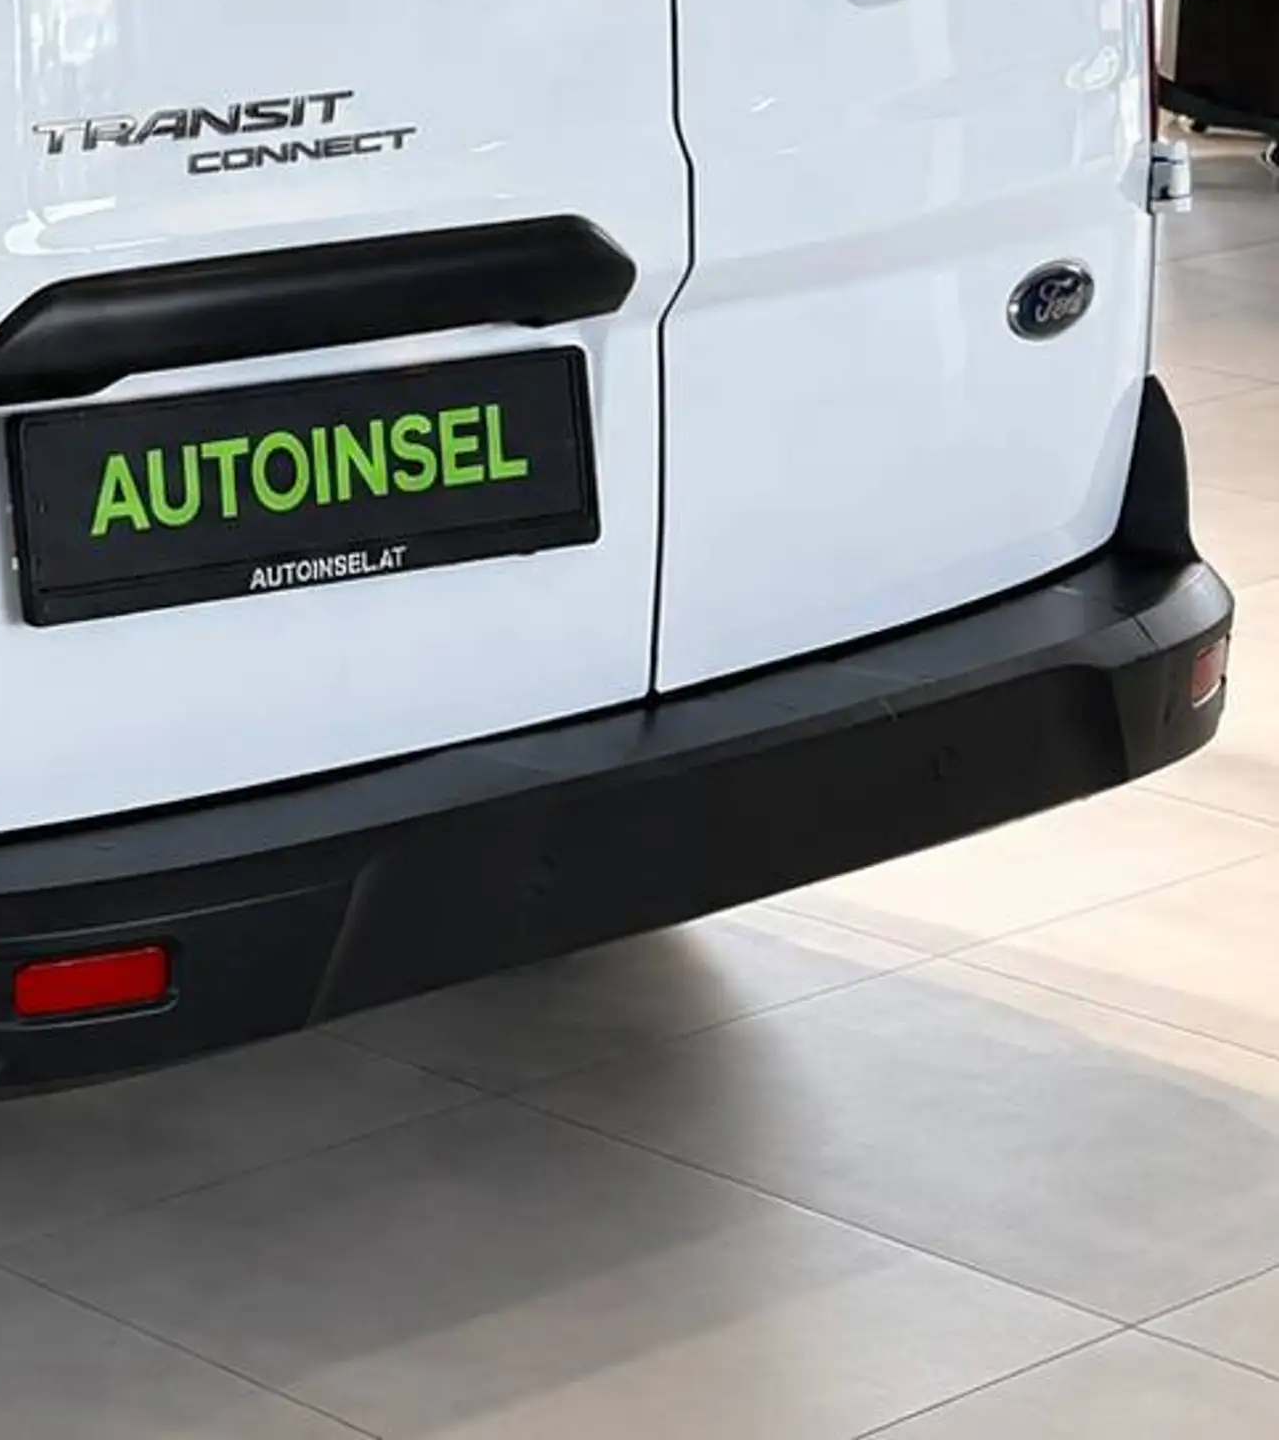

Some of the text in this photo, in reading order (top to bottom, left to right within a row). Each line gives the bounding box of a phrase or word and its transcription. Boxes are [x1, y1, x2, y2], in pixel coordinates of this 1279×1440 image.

[33, 90, 354, 155] TRANSIT
[188, 127, 417, 174] CONNECT
[90, 404, 529, 536] AUTOINSEL
[250, 545, 407, 590] AUTOINSEL.AT
